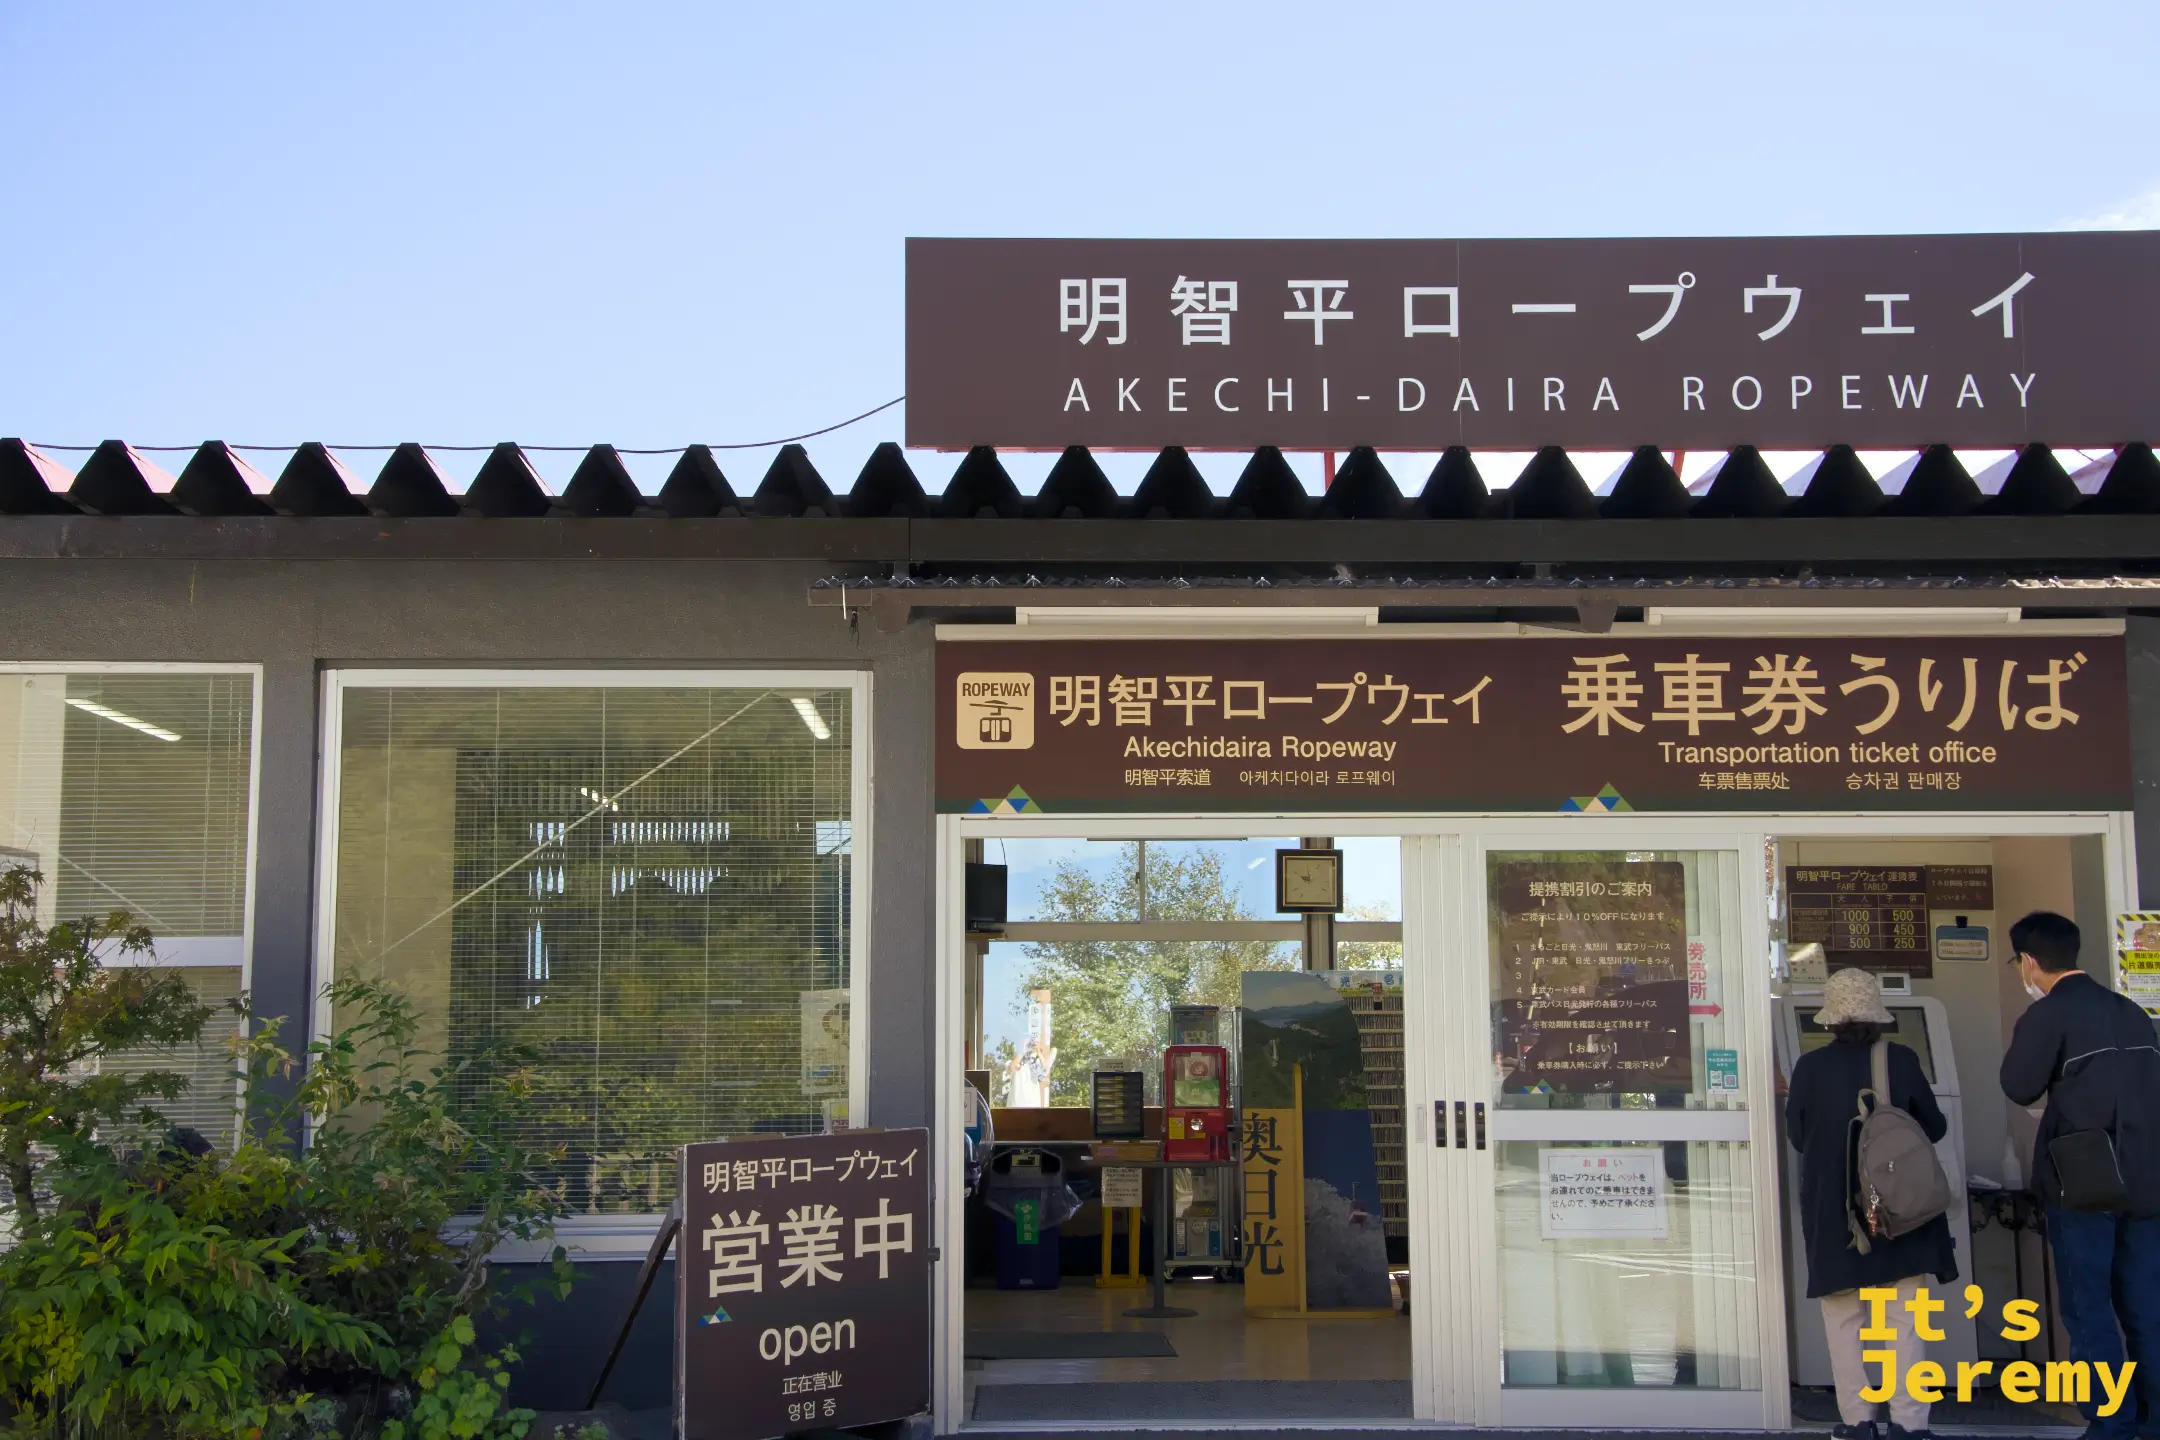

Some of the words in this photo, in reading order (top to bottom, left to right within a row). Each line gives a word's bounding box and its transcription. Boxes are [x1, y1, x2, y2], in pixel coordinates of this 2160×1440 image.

[1059, 271, 2036, 346] 明智平ロープウェイ
[1063, 377, 1620, 412] AKECHI-DAIRA
[1683, 373, 2038, 410] ROPEWAY
[961, 682, 1031, 698] ROPEWAY
[1049, 671, 1493, 727] 明智平ロープウェイ
[1560, 651, 2088, 736] 乗車券うりば
[1123, 735, 1272, 758] Akechidaira
[1282, 735, 1397, 762] Ropeway
[1657, 741, 1840, 767] Transportation
[1848, 741, 1920, 763] ticket
[1929, 740, 1997, 763] office
[1124, 768, 1212, 787] 明智平索道
[1239, 769, 1331, 787] 아케치다이라
[1335, 769, 1396, 787] 로프웨이
[1698, 771, 1790, 790] 车票售票处
[1845, 771, 1899, 790] 승차권
[1907, 771, 1962, 790] 판매장
[1529, 881, 1652, 897] 提携割引のご案内
[1836, 882, 1856, 891] FARE
[1842, 910, 1870, 921] 1000
[1892, 910, 1914, 921] 500
[1848, 924, 1870, 935] 900
[1894, 924, 1915, 935] 450
[1849, 938, 1871, 949] 500
[1894, 938, 1915, 949] 250
[1515, 972, 1522, 980] 3
[703, 1147, 919, 1194] 明智平ロープウェイ
[1242, 1111, 1286, 1276] 奥日光
[702, 1197, 913, 1298] 営業中
[759, 1318, 856, 1366] open
[782, 1370, 843, 1395] 正在营业
[788, 1400, 816, 1422] 영업
[822, 1398, 837, 1417] 중
